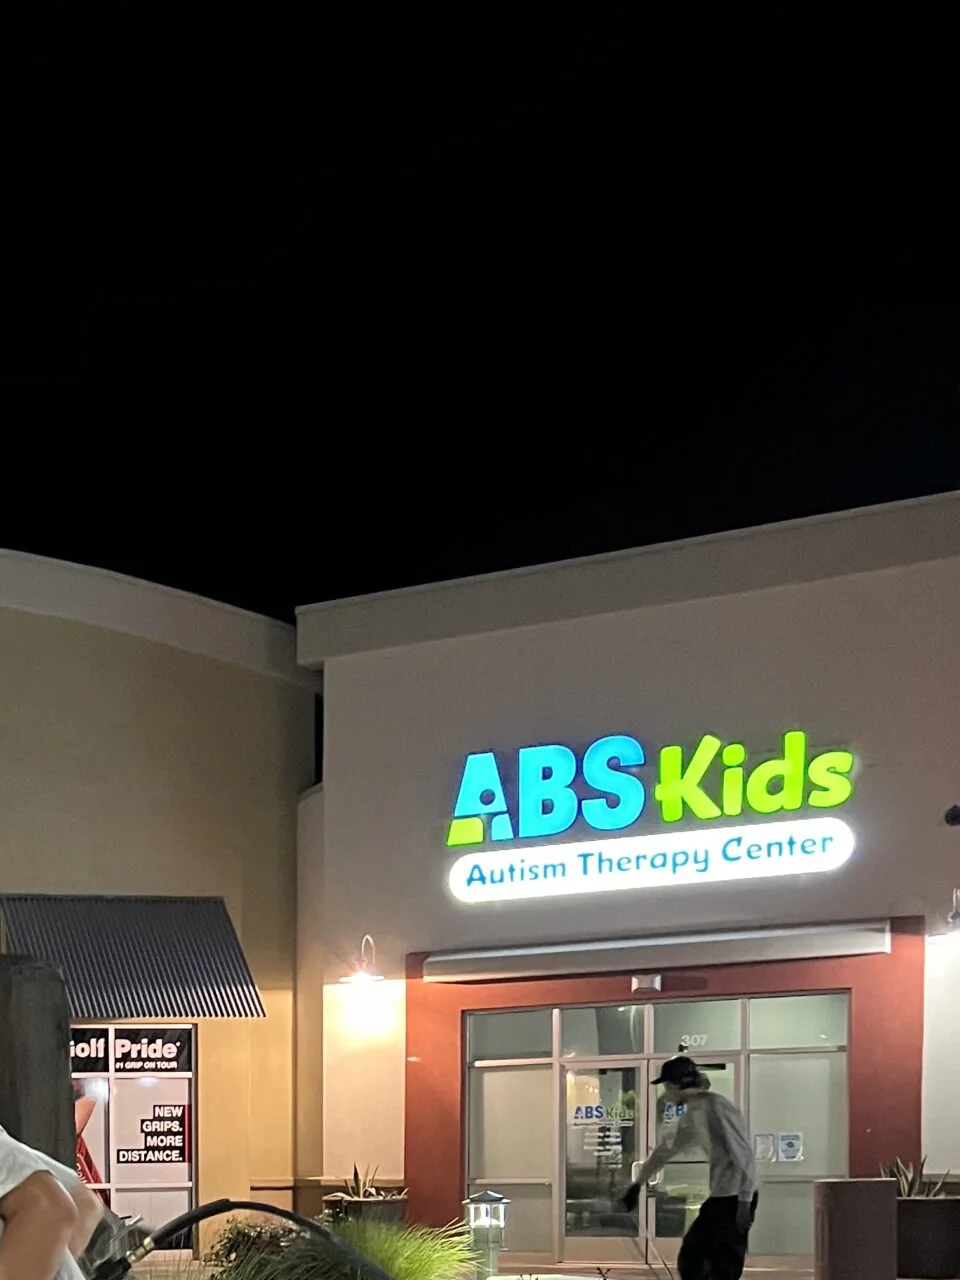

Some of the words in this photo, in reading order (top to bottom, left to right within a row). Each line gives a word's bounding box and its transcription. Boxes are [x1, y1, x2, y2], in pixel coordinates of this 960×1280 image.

[447, 734, 647, 846] ABS
[655, 731, 855, 822] Kids
[465, 858, 567, 886] Autism
[578, 846, 710, 873] Therapy
[721, 834, 834, 862] Center
[680, 1034, 709, 1047] 307
[115, 1038, 178, 1059] Pride
[154, 1106, 184, 1118] NEW
[574, 1105, 604, 1119] ABS
[606, 1107, 633, 1119] Kids
[142, 1119, 183, 1132] GRIPS.
[146, 1135, 184, 1147] MORE
[119, 1149, 183, 1162] DISTANCE.
